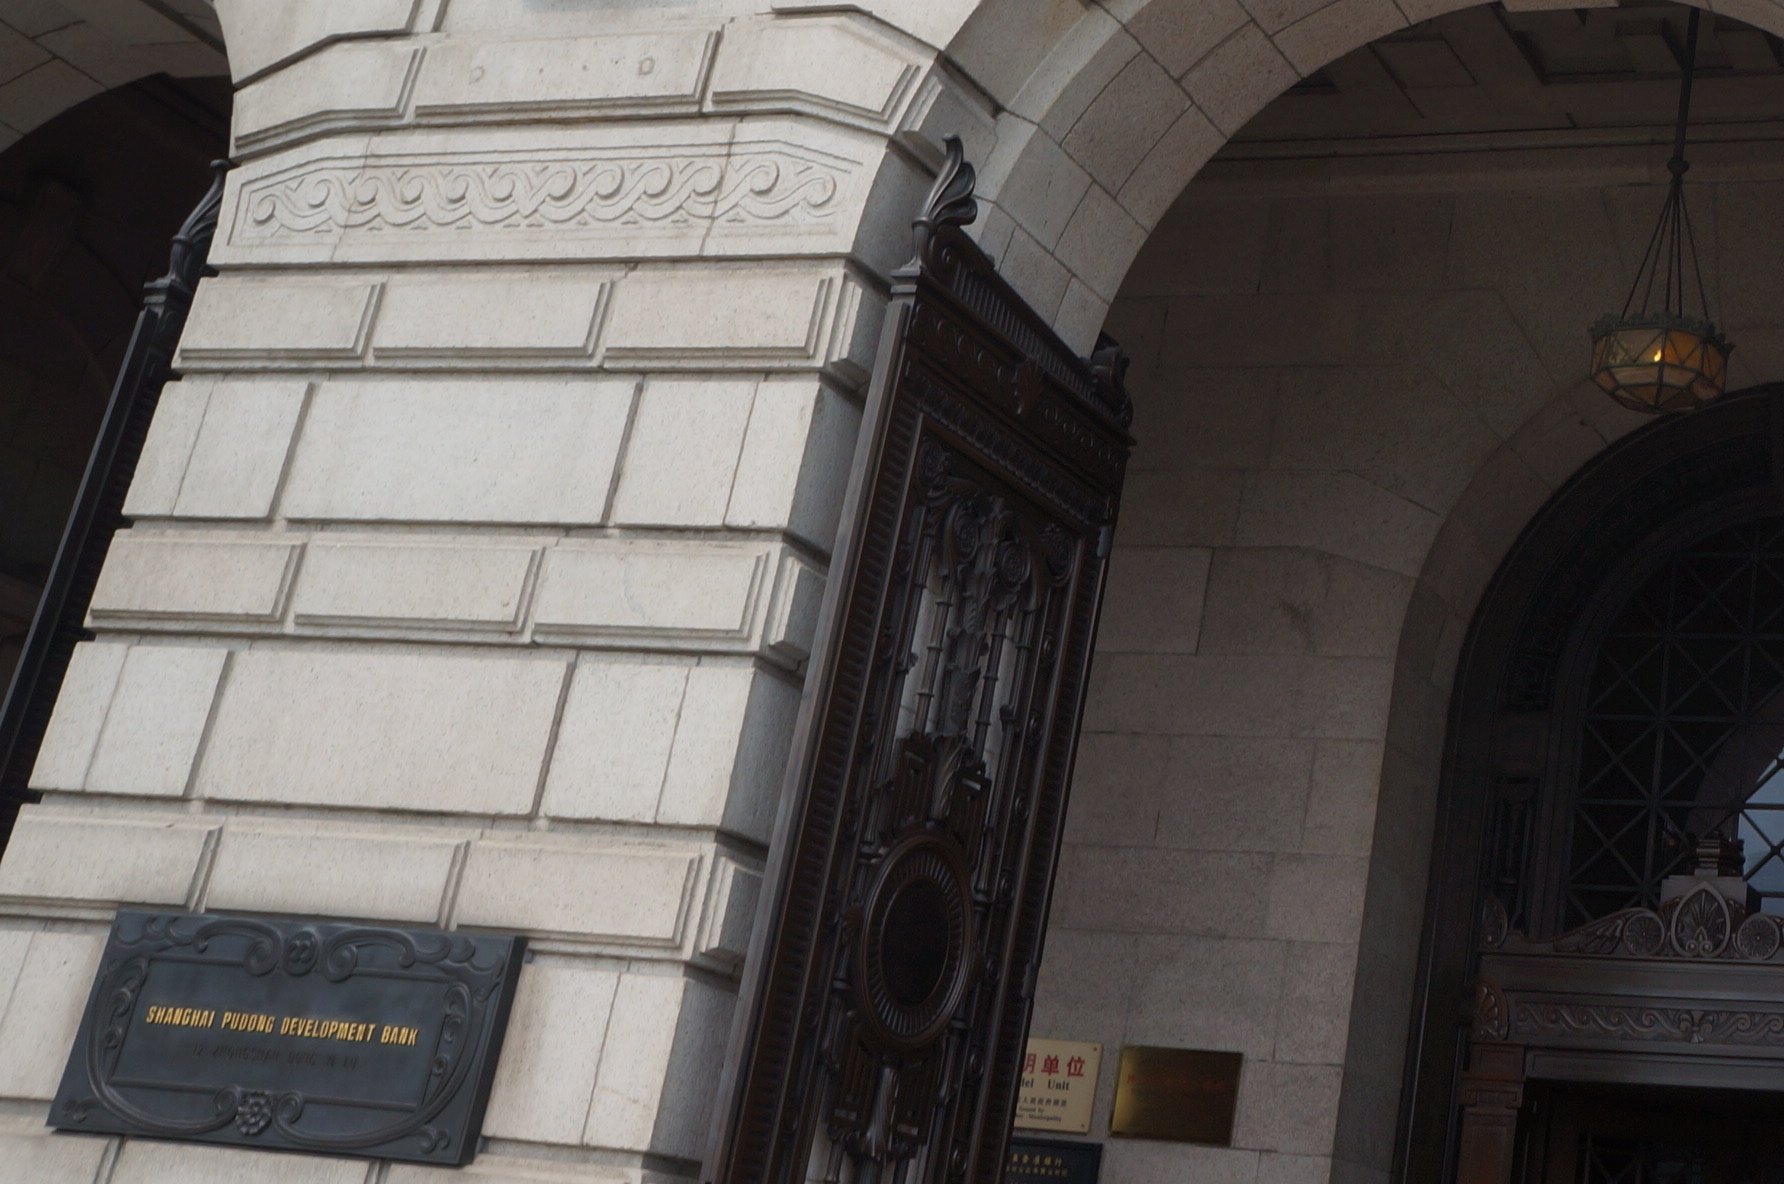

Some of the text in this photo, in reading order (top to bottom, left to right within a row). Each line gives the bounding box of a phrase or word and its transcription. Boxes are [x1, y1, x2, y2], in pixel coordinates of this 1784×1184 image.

[146, 1006, 418, 1047] SHANGHAI PUDONG DEVELOPMENT BANK
[1047, 1078, 1070, 1091] Unit
